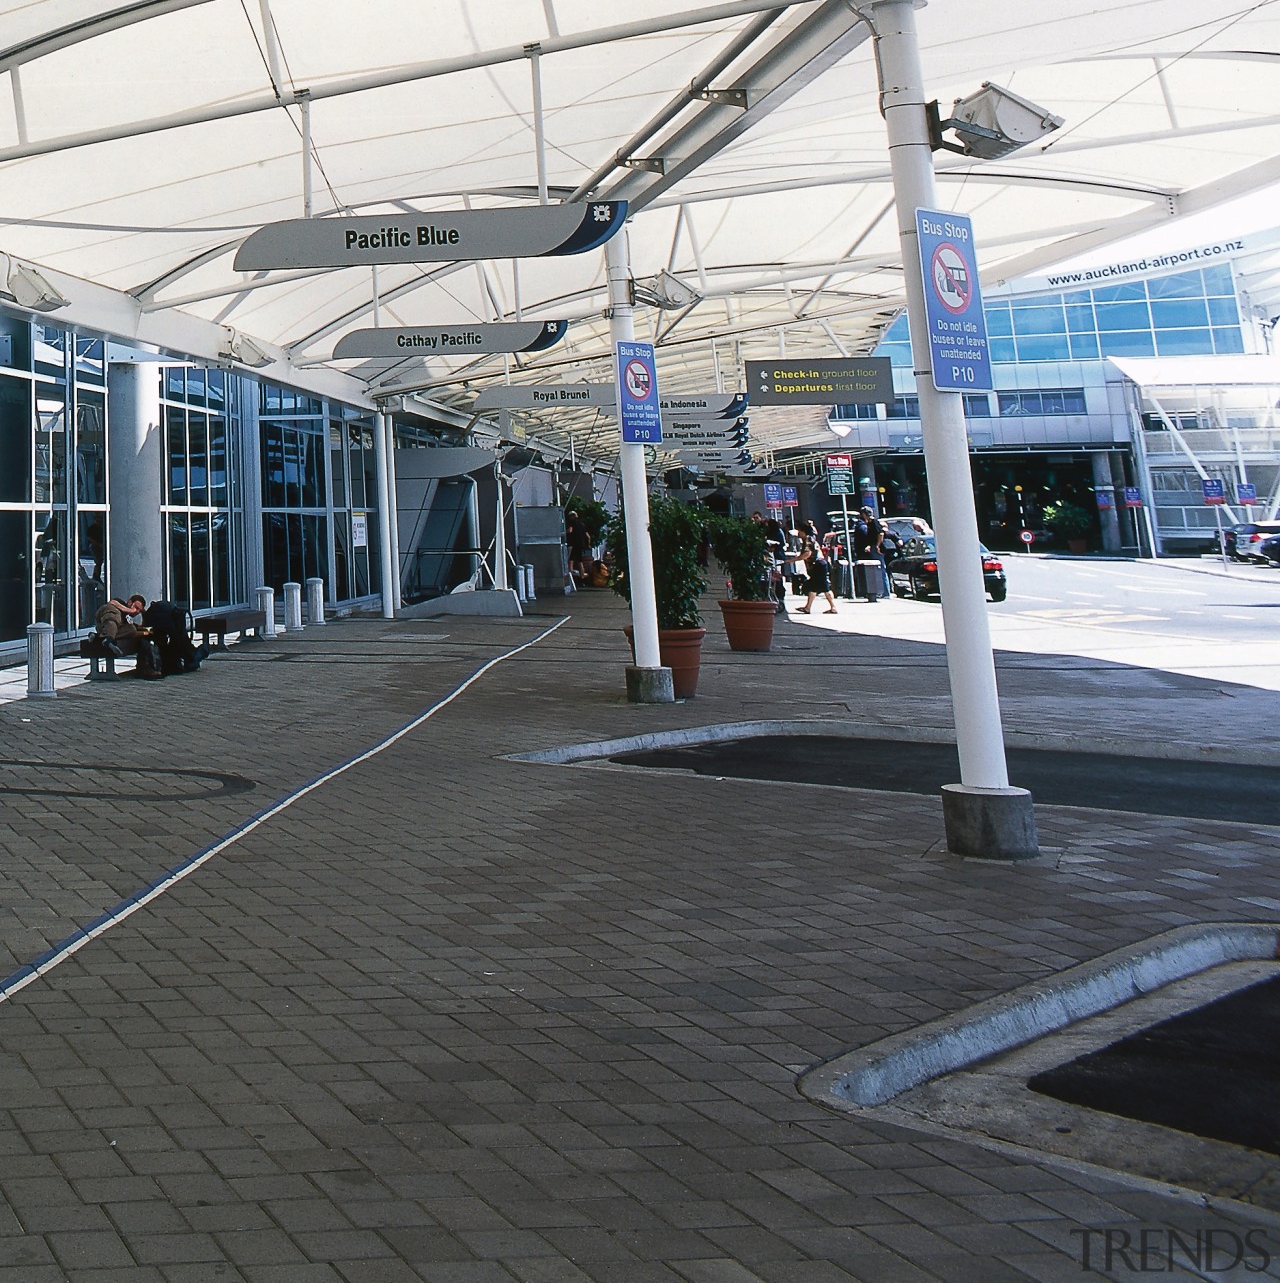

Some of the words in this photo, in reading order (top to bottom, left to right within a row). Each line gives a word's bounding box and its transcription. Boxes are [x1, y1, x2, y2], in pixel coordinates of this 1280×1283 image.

[345, 227, 411, 249] Pacific
[417, 225, 460, 246] Blue
[922, 219, 942, 236] Bus
[945, 222, 968, 243] Stop
[1047, 240, 1245, 286] www.auckland-airport.co.nz
[937, 319, 949, 331] Do
[950, 321, 962, 332] not
[963, 321, 977, 333] idle
[397, 334, 438, 349] Cathay
[441, 331, 482, 346] Pacific
[932, 333, 955, 345] buses
[957, 336, 965, 345] or
[966, 335, 986, 347] leave
[621, 346, 634, 357] Bus
[635, 347, 652, 359] Stop
[940, 348, 982, 360] unattended
[773, 370, 819, 379] Check-in
[822, 370, 855, 380] ground
[857, 369, 878, 377] floor
[952, 366, 975, 383] P10
[774, 383, 833, 393] Departures
[835, 383, 853, 391] first
[856, 383, 876, 391] floor
[533, 390, 558, 402] Royal
[560, 389, 590, 400] Brunei
[670, 399, 707, 408] Indonesia
[634, 429, 650, 439] P10
